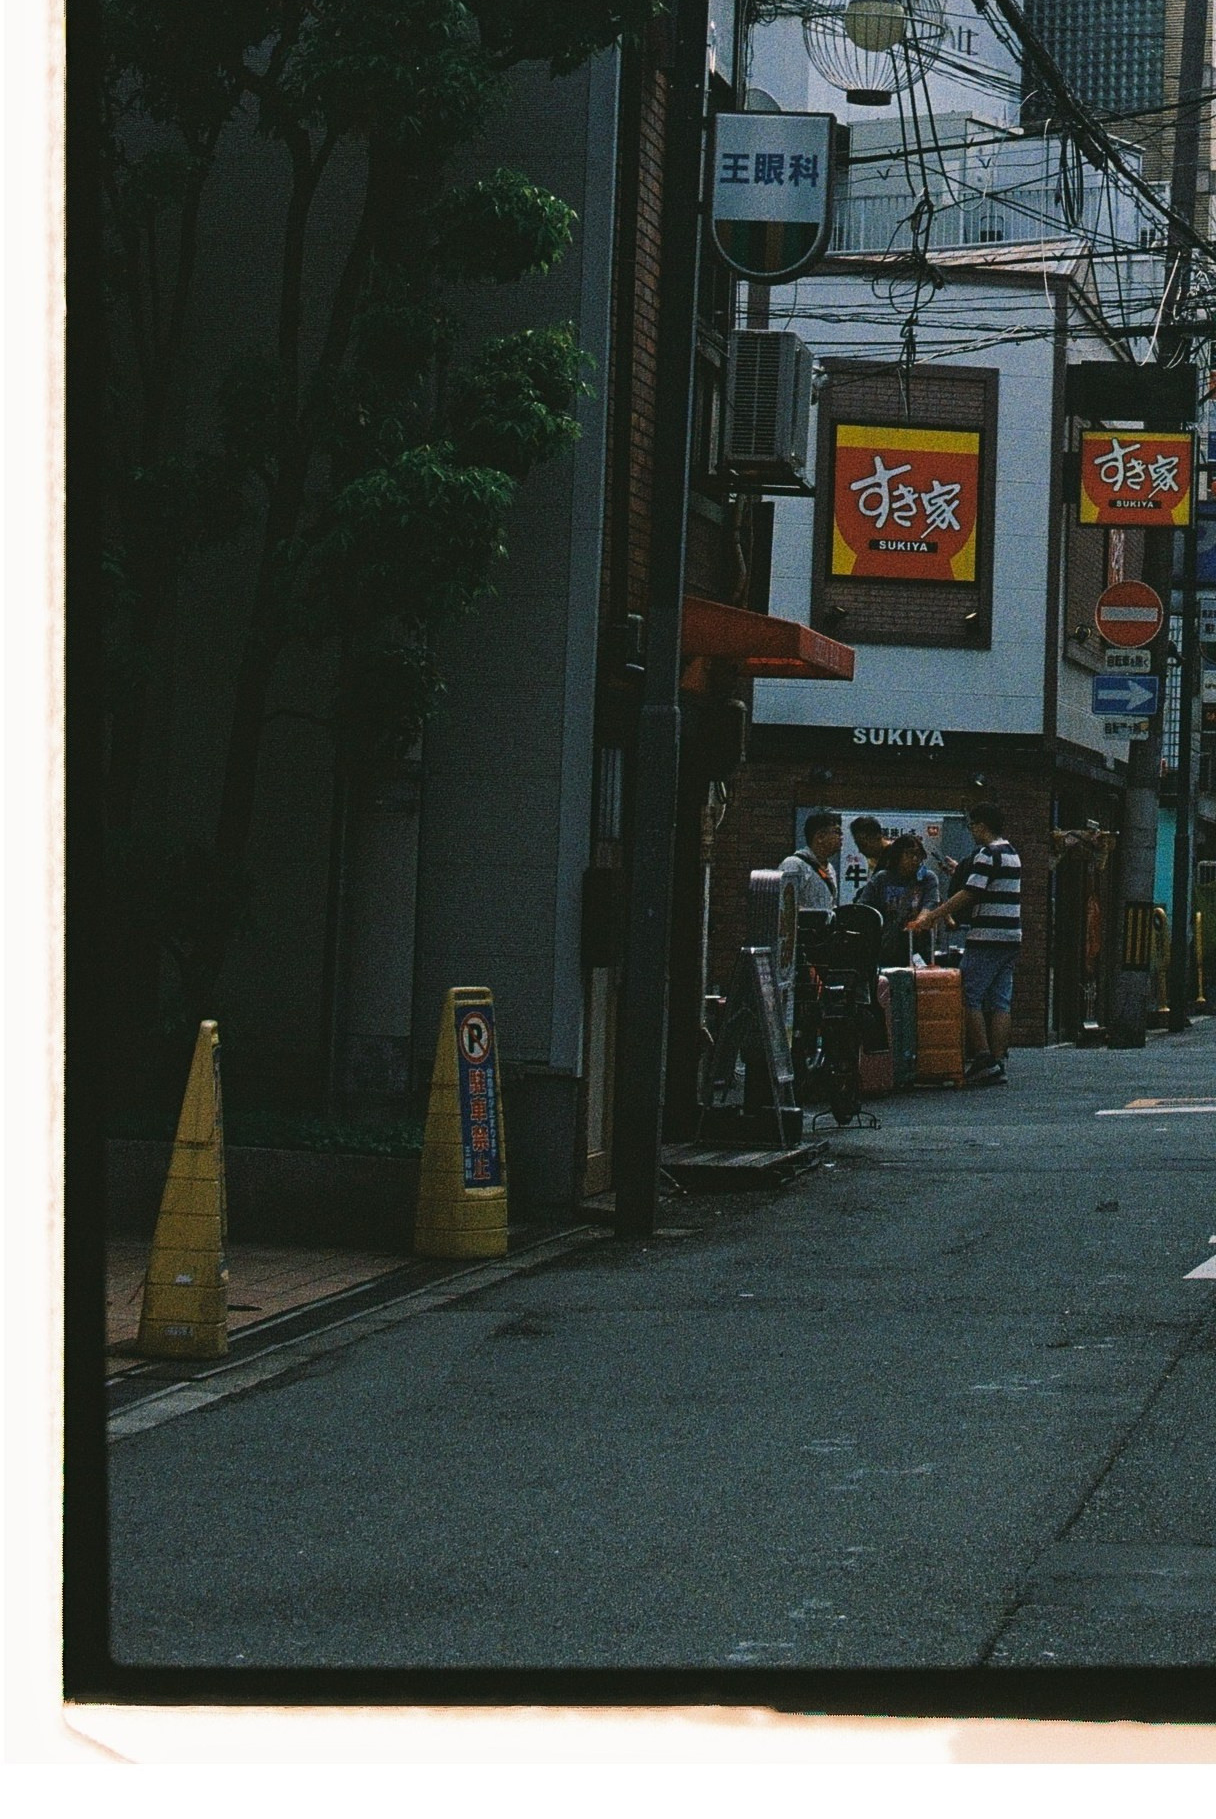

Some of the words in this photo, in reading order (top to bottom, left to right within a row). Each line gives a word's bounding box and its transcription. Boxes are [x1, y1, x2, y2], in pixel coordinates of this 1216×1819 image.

[719, 152, 820, 189] 王眼科
[1094, 438, 1179, 499] すき家
[849, 456, 962, 539] すき家
[1115, 499, 1156, 509] SUKIYA
[877, 539, 929, 552] SUKIYA
[852, 728, 945, 747] SUKIYA
[468, 1067, 492, 1181] 駐車禁止
